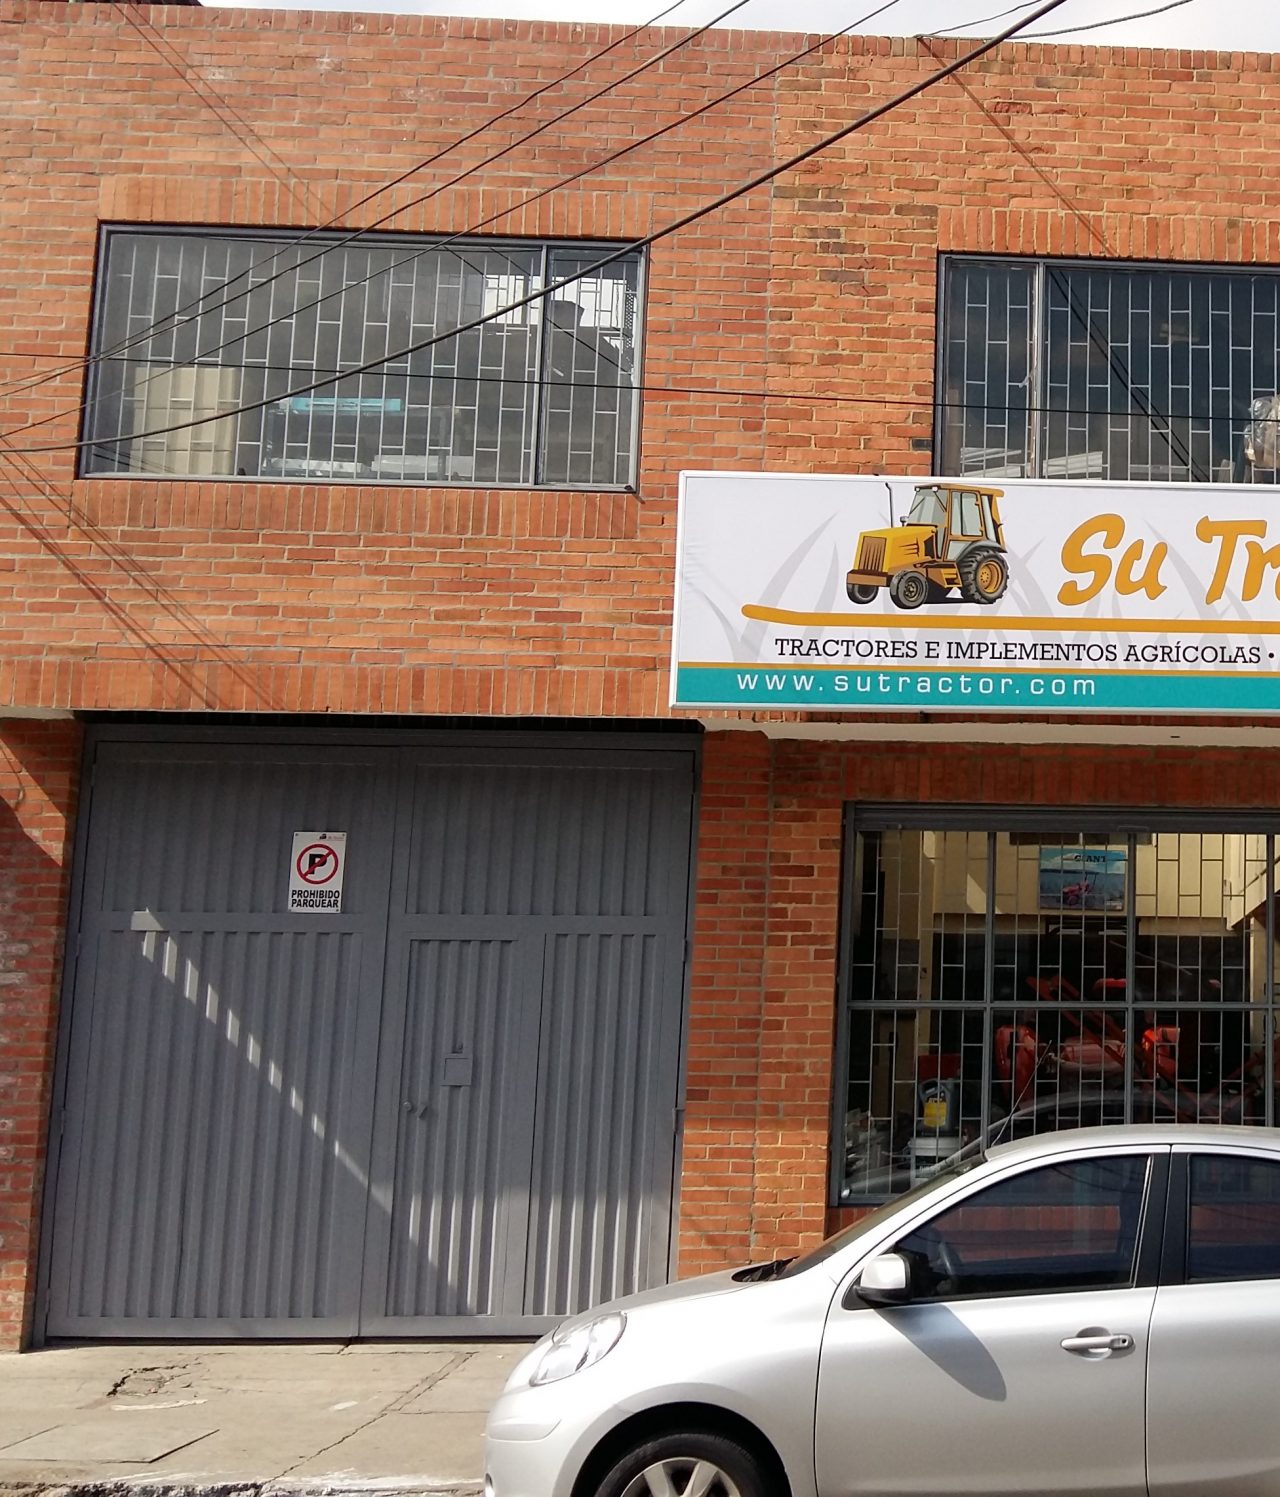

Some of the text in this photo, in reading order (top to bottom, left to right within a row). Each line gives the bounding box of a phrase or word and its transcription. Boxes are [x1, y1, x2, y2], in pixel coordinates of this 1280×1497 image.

[1057, 513, 1168, 606] Su
[775, 638, 918, 659] TRACTORES
[924, 641, 940, 659] E
[946, 641, 1118, 662] IMPLEMENTOS
[1124, 640, 1261, 664] AGRÍCOLAS
[736, 673, 1096, 696] www.sutractor.com
[291, 889, 341, 899] PROHIBIDO
[291, 899, 339, 908] PARQUEAR
